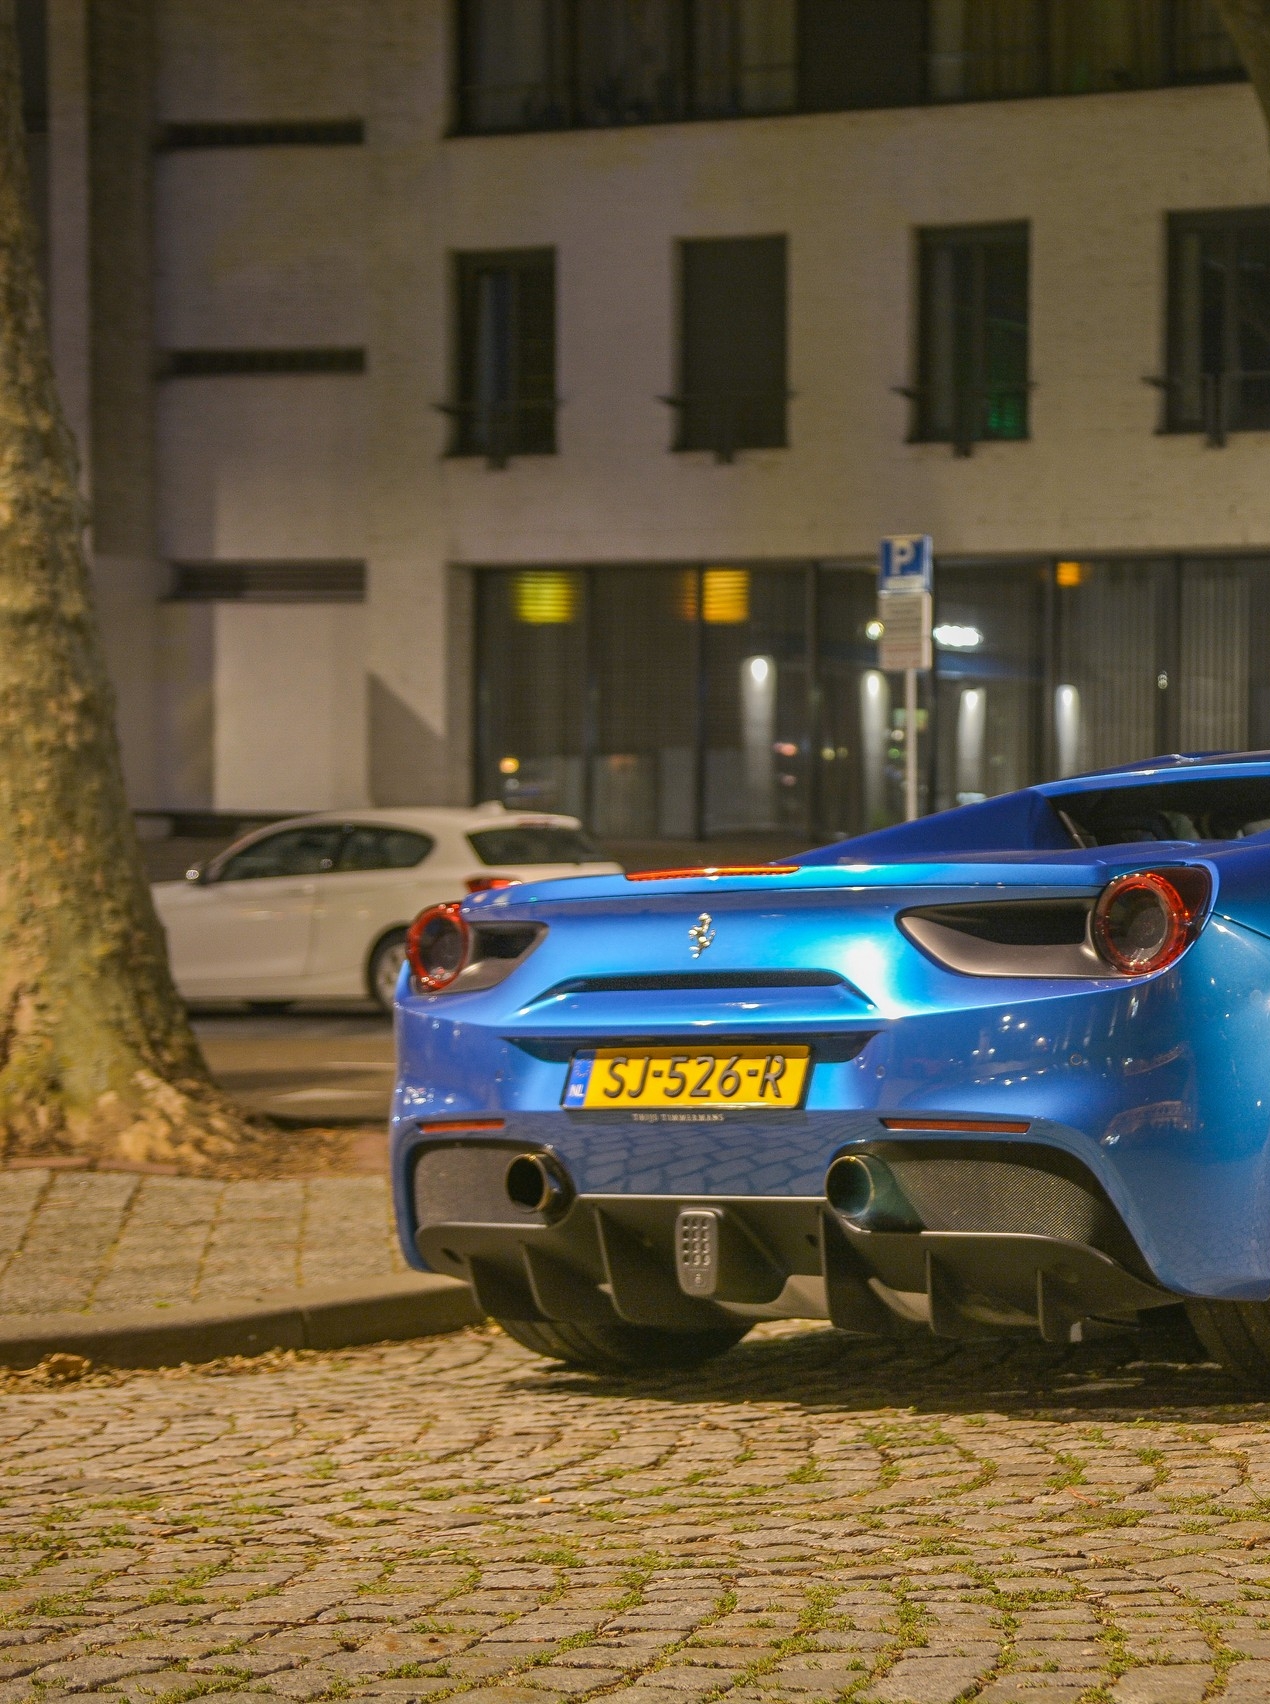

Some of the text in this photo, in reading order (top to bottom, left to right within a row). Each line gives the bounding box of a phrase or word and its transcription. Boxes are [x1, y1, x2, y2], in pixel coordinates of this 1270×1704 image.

[890, 540, 916, 575] P
[568, 1083, 585, 1097] NL
[603, 1055, 787, 1099] SJ-526-R
